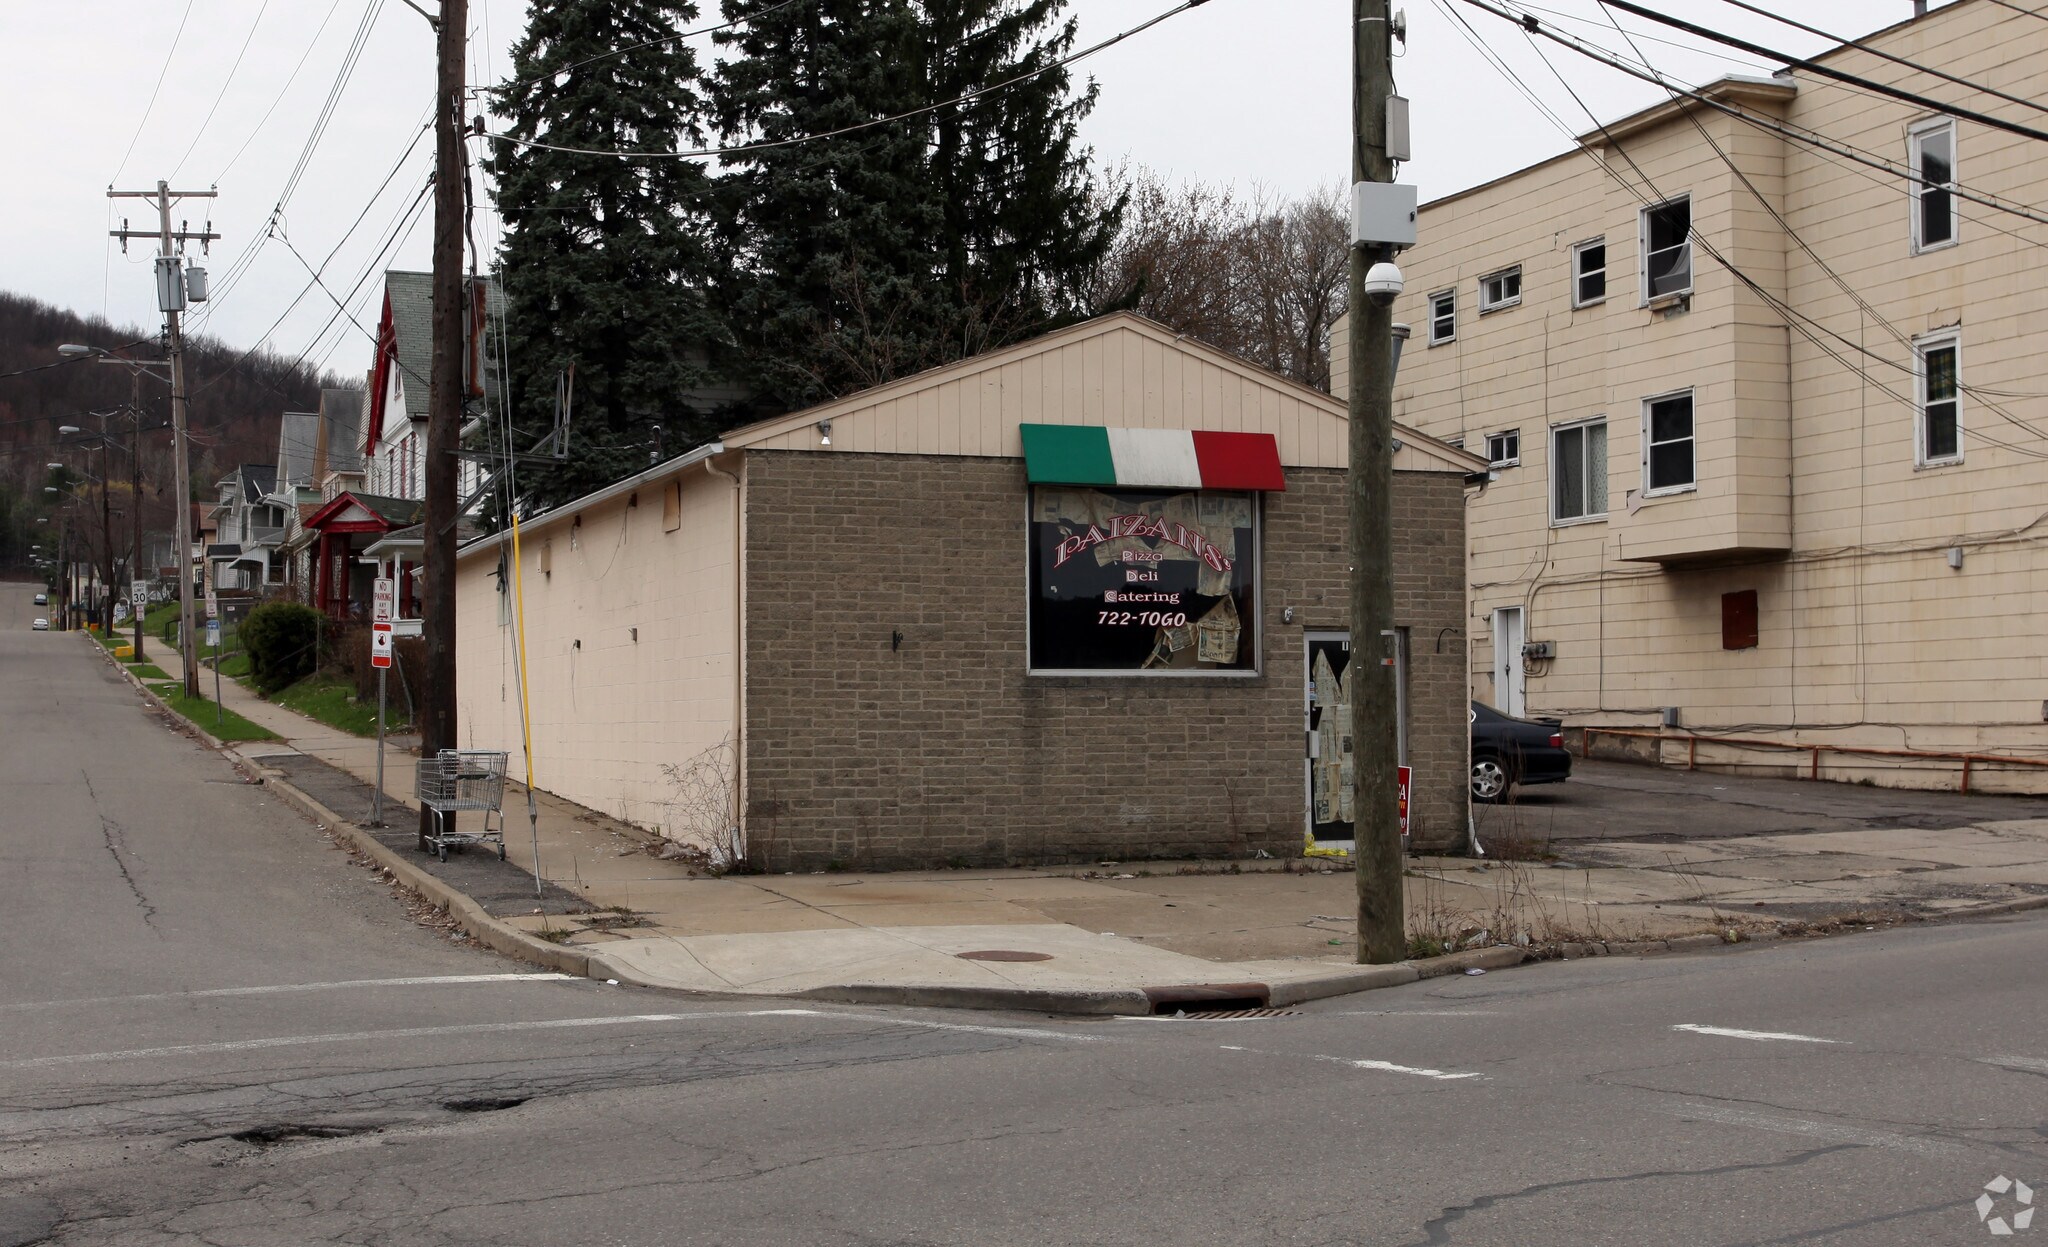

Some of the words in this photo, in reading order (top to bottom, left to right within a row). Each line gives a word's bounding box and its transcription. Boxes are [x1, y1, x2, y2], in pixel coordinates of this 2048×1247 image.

[1122, 550, 1164, 562] Pizza
[1126, 570, 1159, 583] Deli
[379, 582, 387, 592] NO
[133, 592, 146, 603] 30
[374, 593, 391, 601] PARKING
[1104, 590, 1181, 605] Catering
[1098, 611, 1186, 627] 722-TOGO
